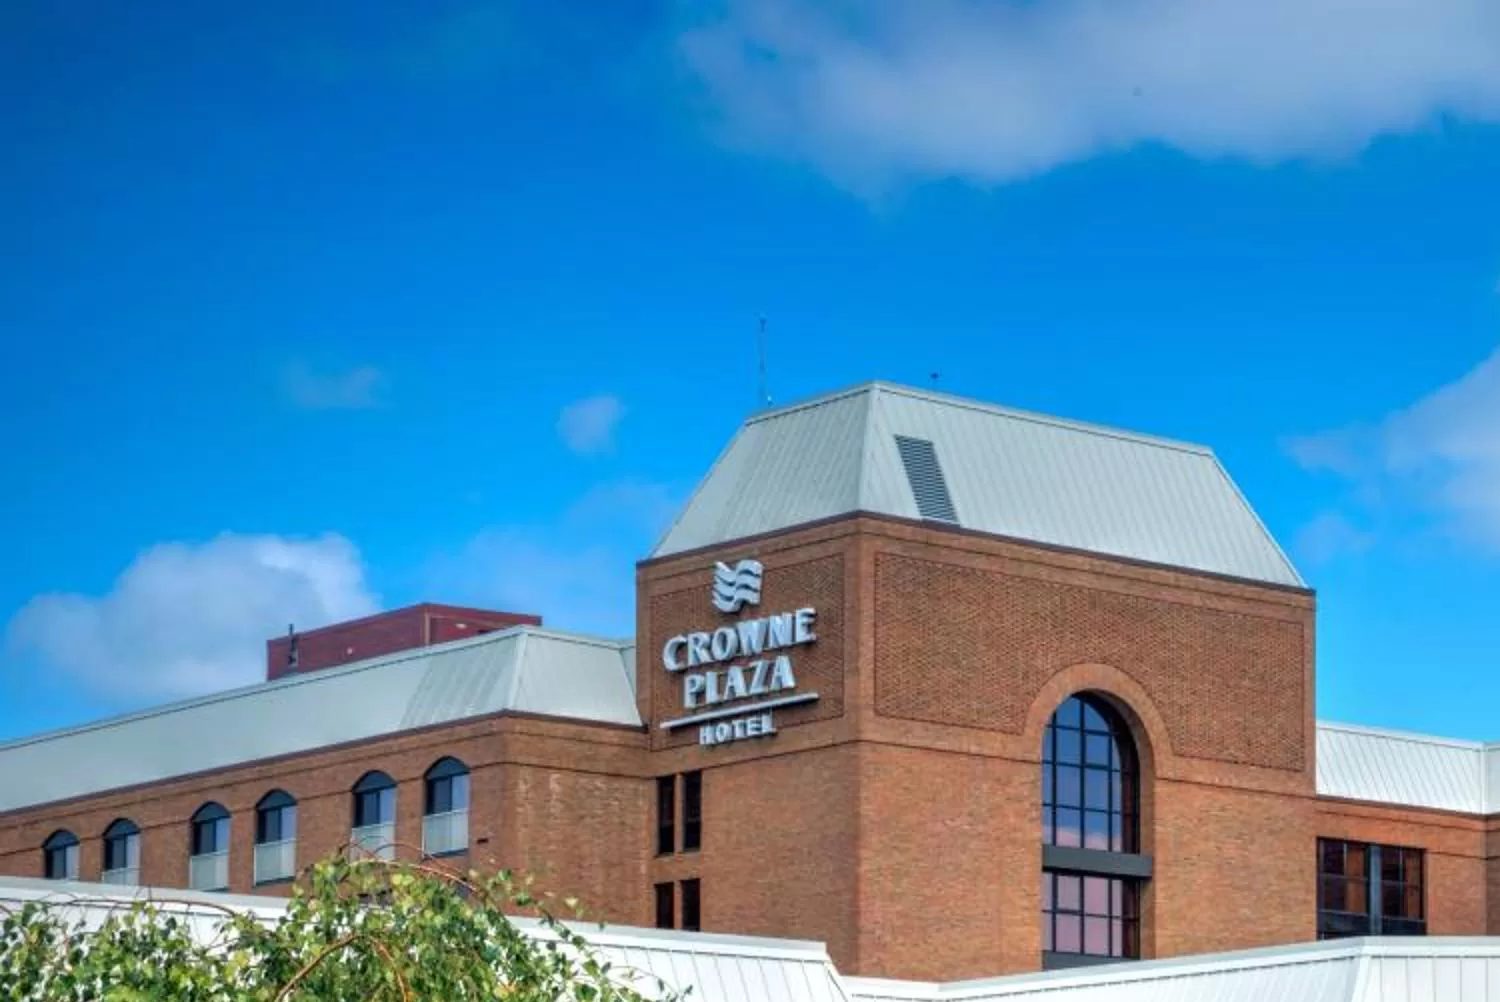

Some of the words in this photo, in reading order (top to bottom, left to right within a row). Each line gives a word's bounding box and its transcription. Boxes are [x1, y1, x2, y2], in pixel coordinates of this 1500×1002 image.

[663, 607, 817, 672] CROWNE
[684, 655, 797, 709] PLAZA
[699, 711, 777, 745] HOTEL
